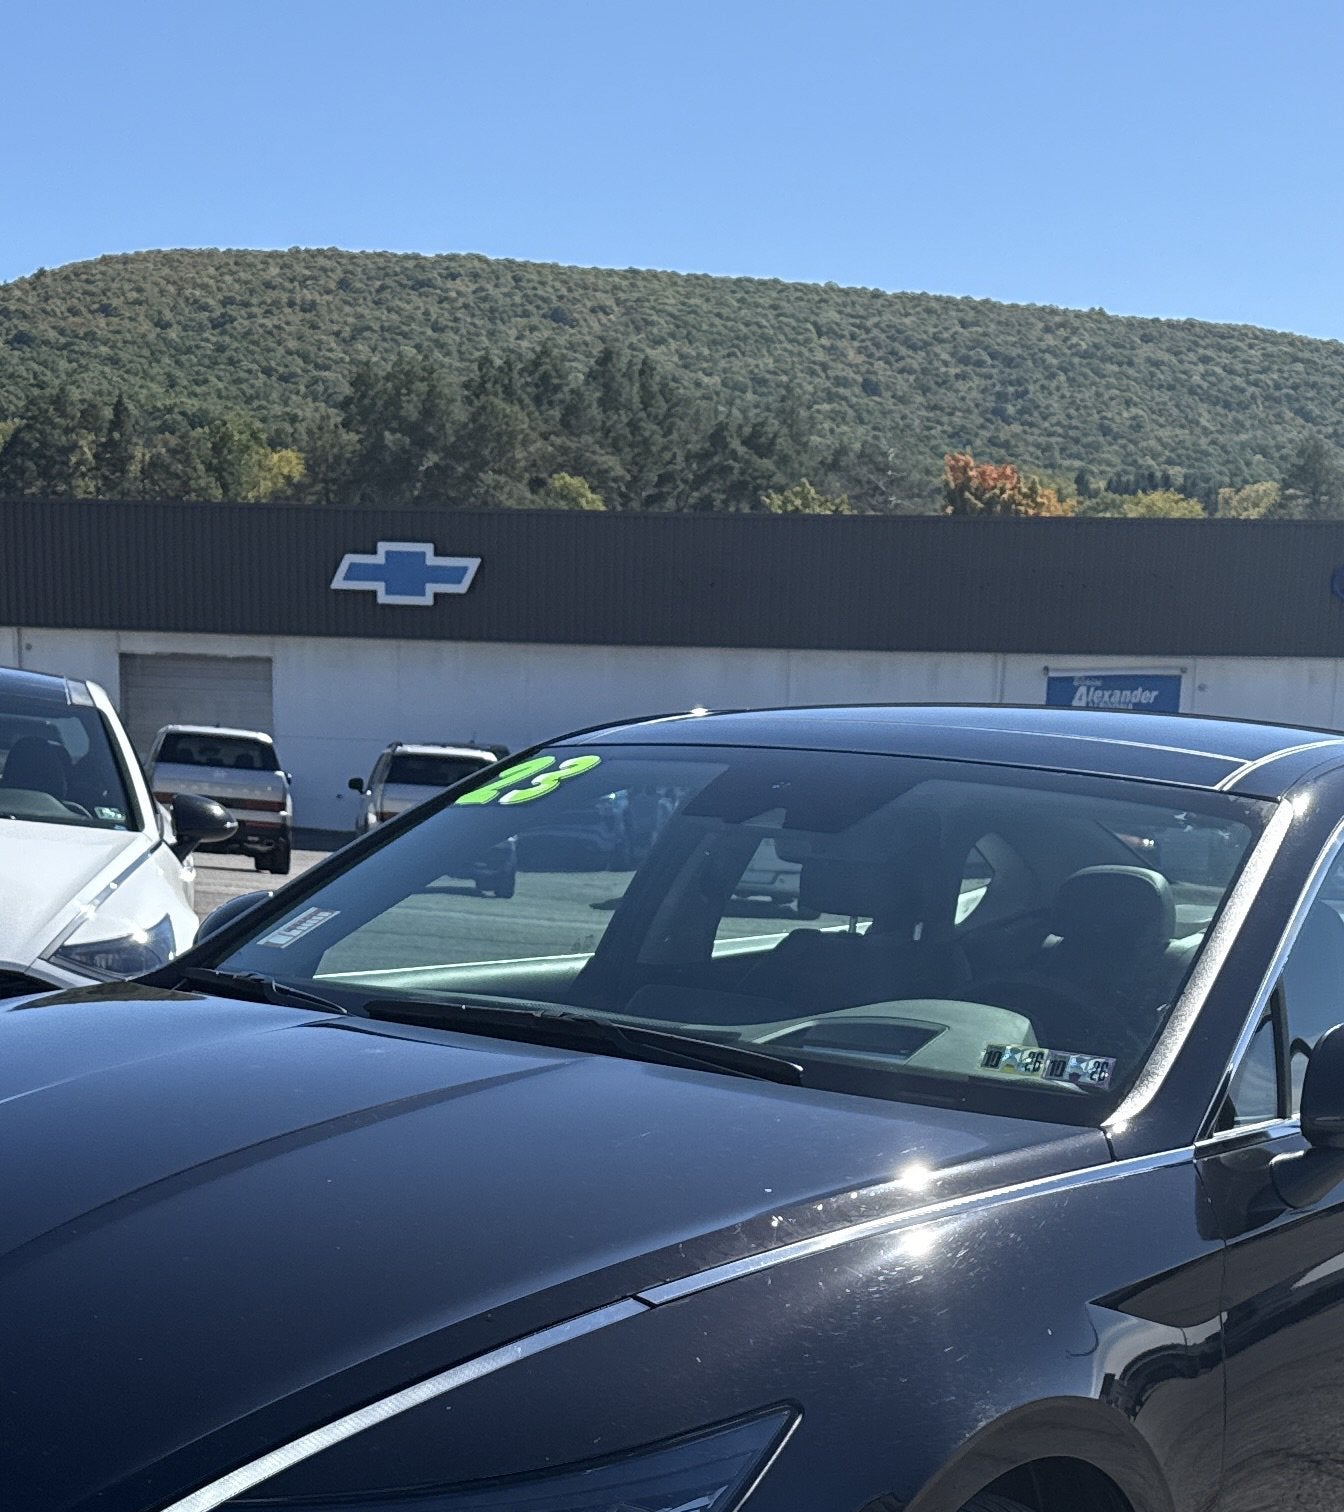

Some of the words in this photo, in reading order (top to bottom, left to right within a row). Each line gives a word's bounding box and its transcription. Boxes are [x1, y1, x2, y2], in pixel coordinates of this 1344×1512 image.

[1071, 685, 1159, 707] Alexander
[455, 755, 602, 805] 23
[1024, 1051, 1045, 1073] 26
